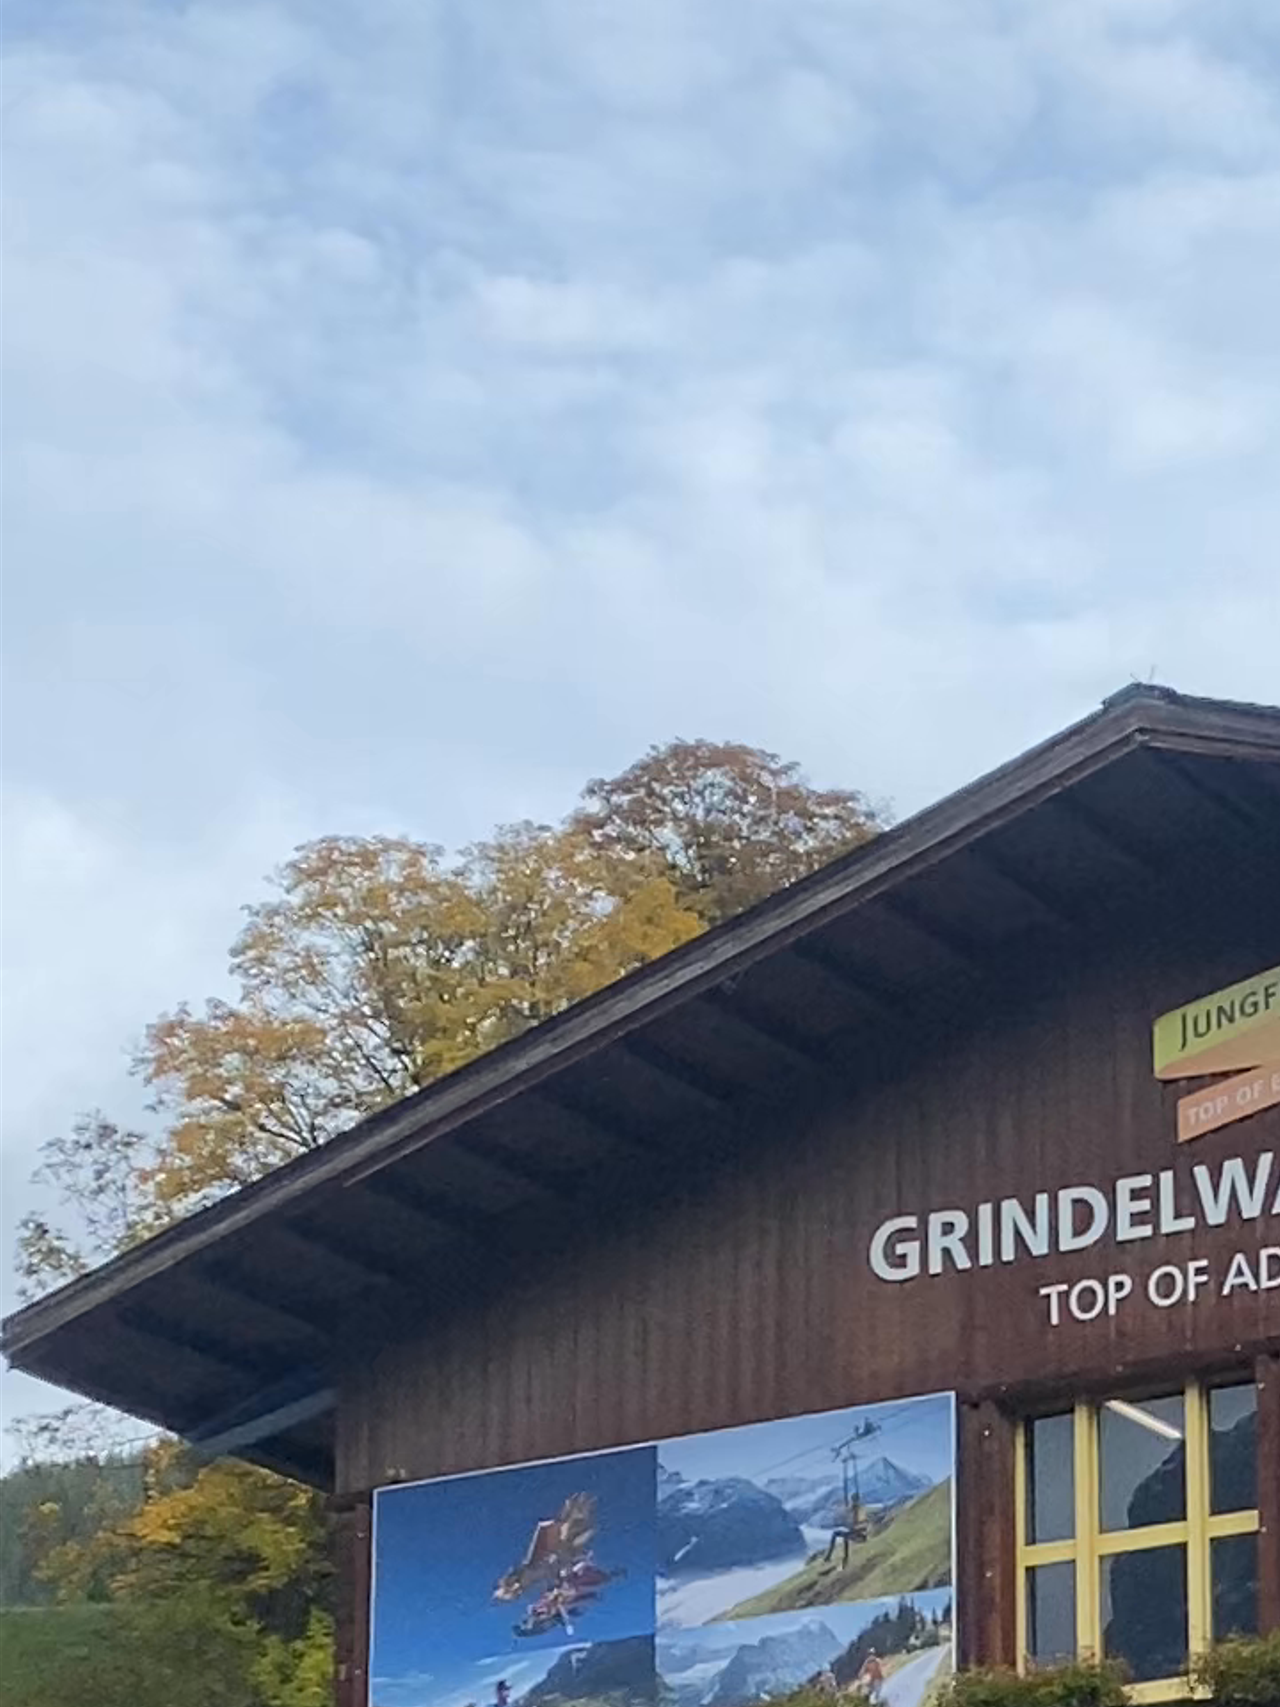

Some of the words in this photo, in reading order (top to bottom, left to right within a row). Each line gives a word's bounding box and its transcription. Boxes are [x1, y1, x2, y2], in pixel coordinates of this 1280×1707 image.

[1187, 1094, 1230, 1126] TOP
[1236, 1079, 1265, 1106] OF
[1040, 1272, 1132, 1327] TOP
[1147, 1258, 1210, 1308] OF
